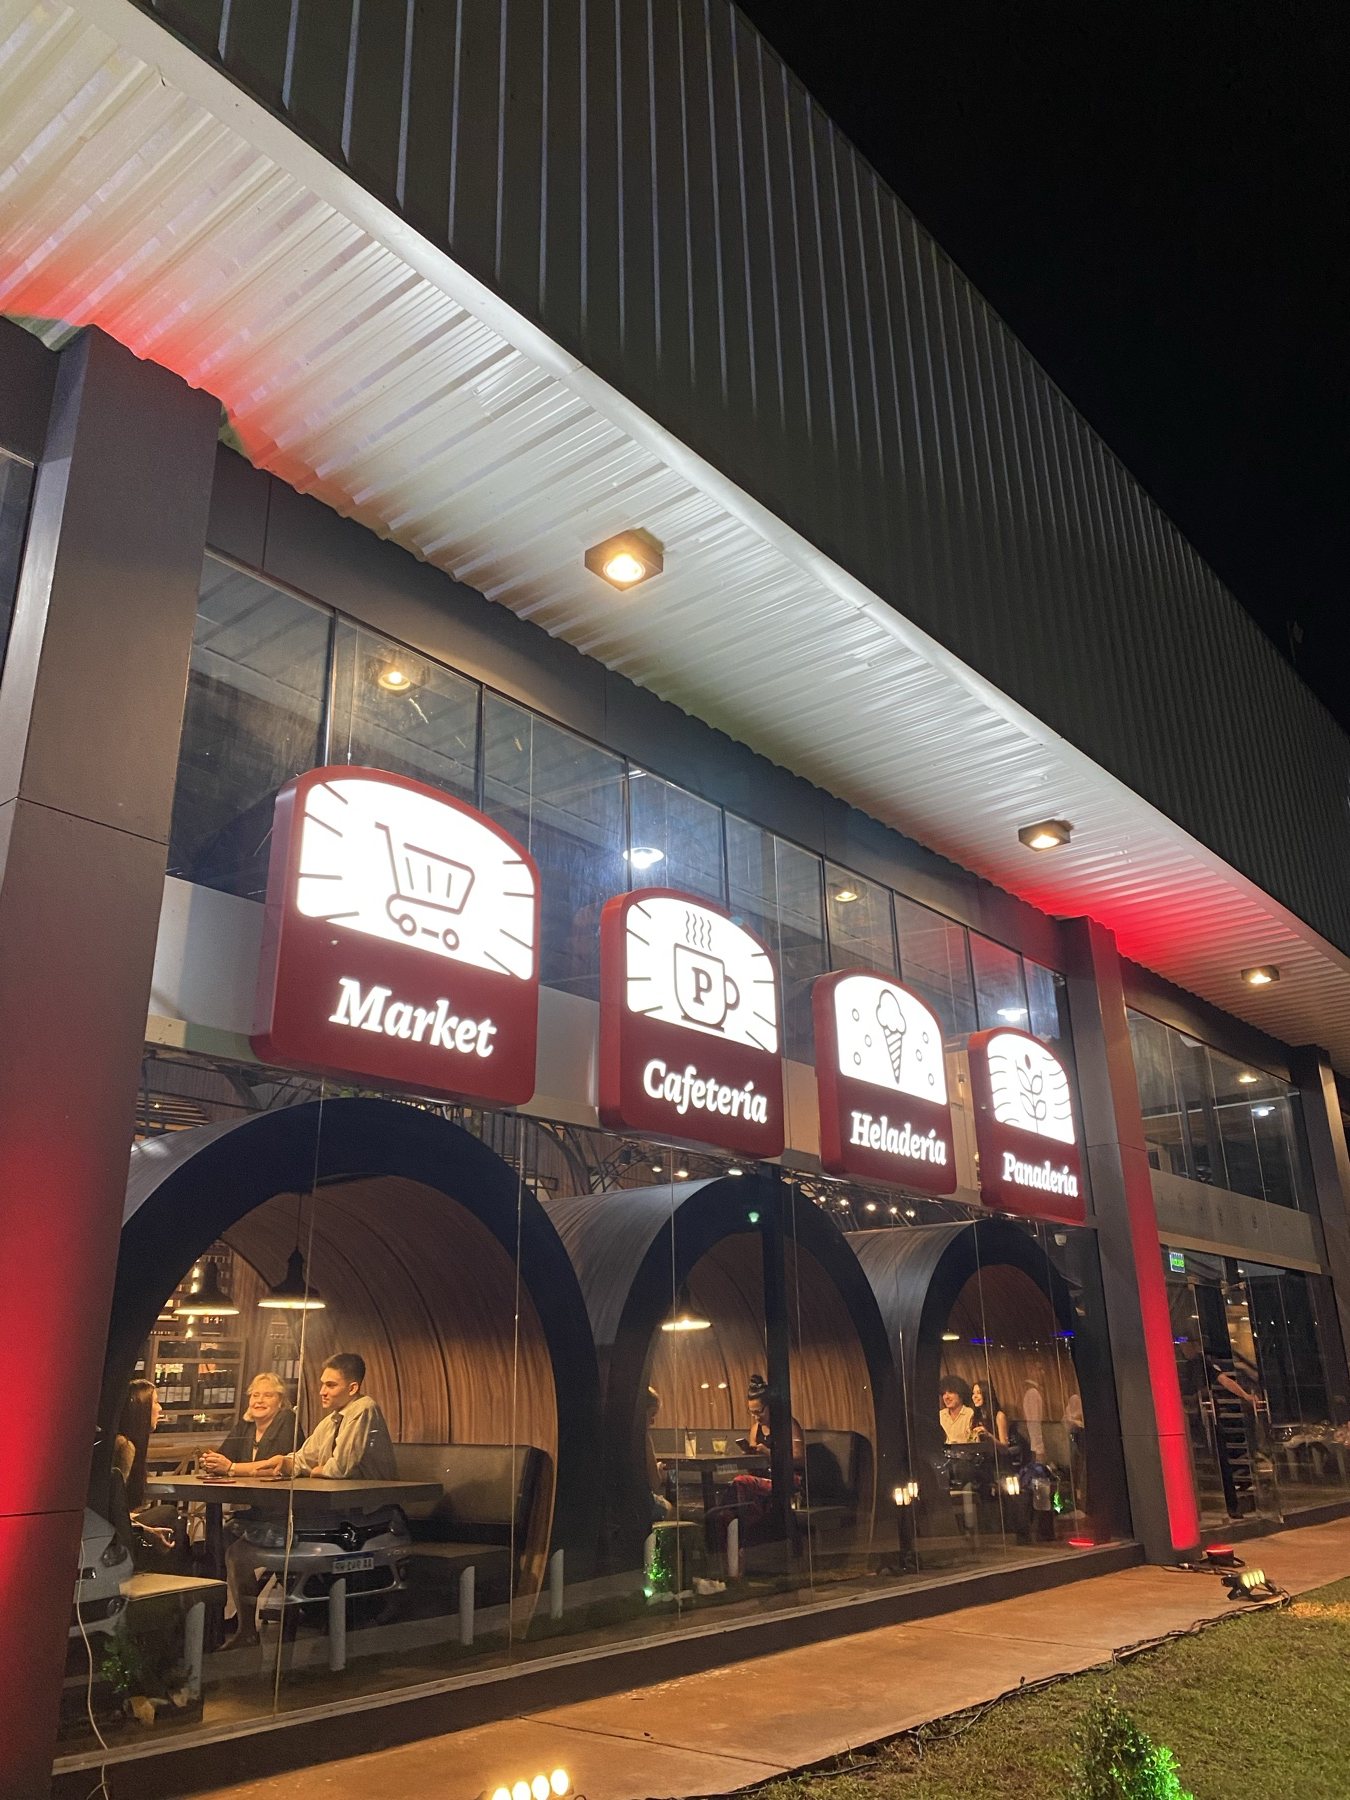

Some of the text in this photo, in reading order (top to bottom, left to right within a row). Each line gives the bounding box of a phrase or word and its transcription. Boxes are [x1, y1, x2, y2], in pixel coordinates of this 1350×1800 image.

[692, 967, 712, 1006] P
[329, 977, 498, 1058] Market
[643, 1058, 768, 1124] Cafetería
[850, 1111, 947, 1166] Heladería
[1002, 1152, 1079, 1198] Panadería
